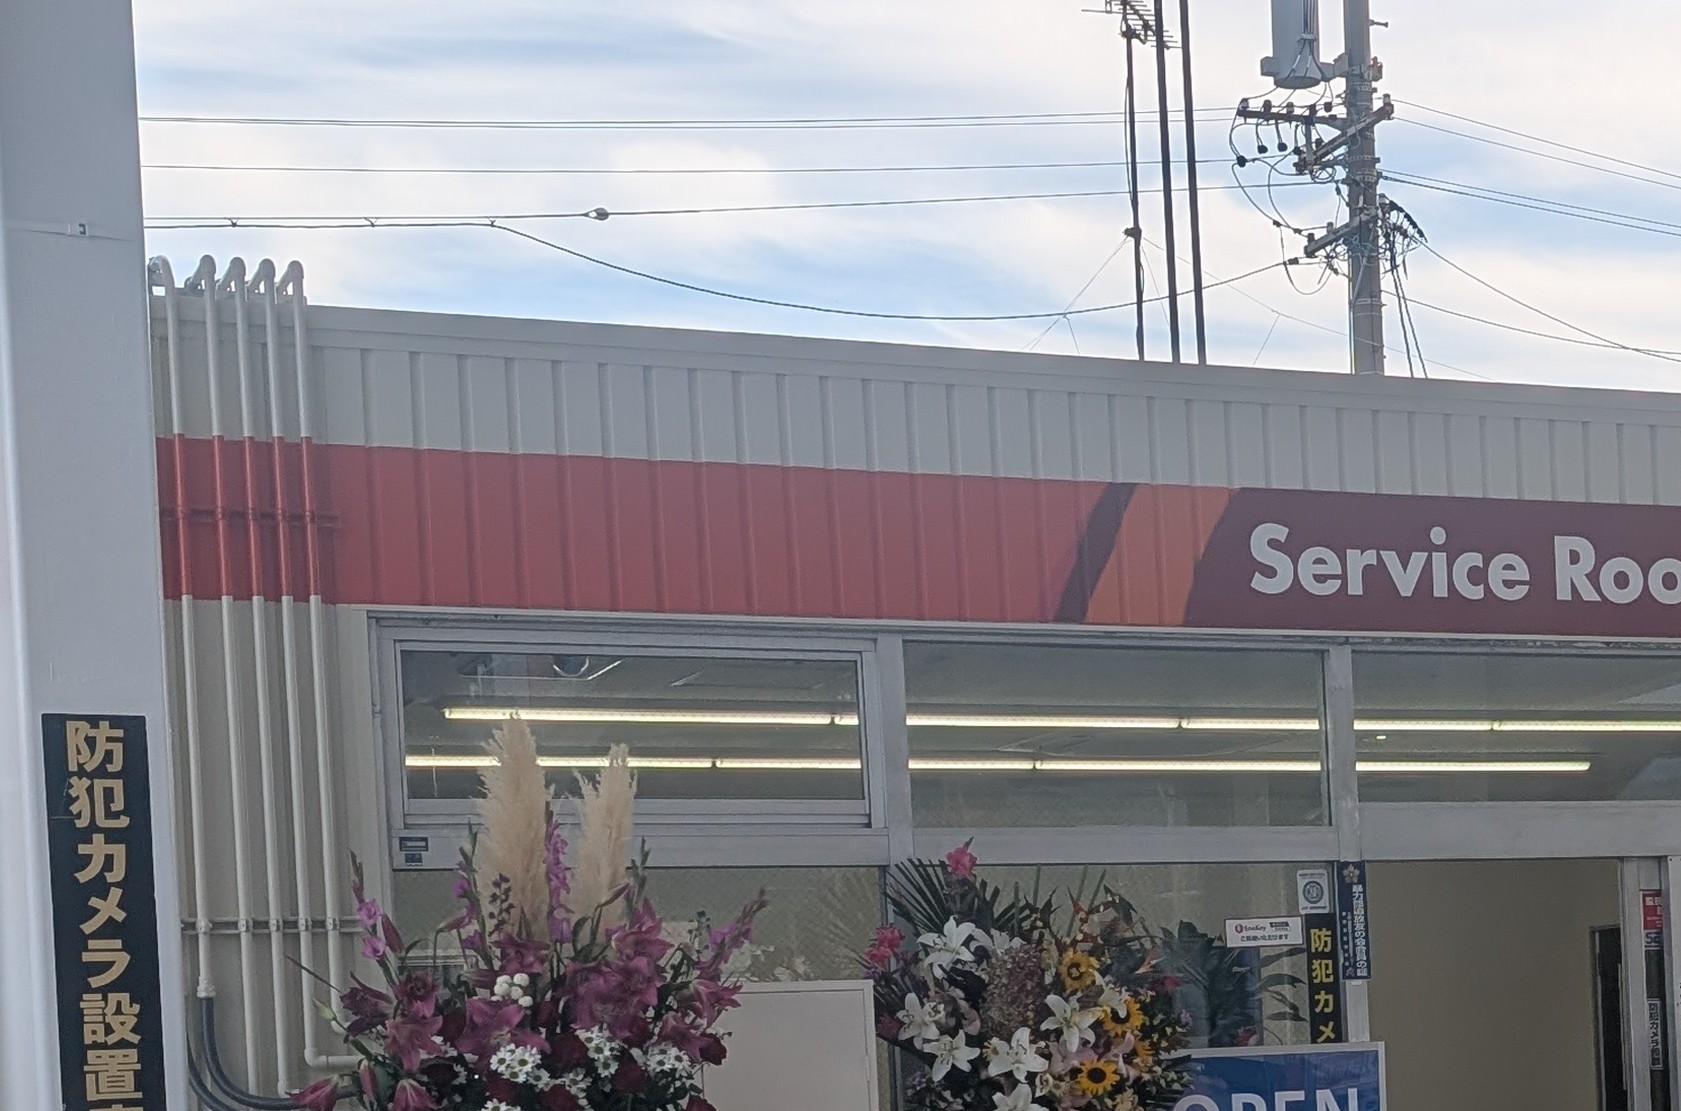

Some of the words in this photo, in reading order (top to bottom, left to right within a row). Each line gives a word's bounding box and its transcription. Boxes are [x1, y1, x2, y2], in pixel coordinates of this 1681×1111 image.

[1249, 522, 1530, 601] Service
[1310, 927, 1336, 1043] 防犯カメ
